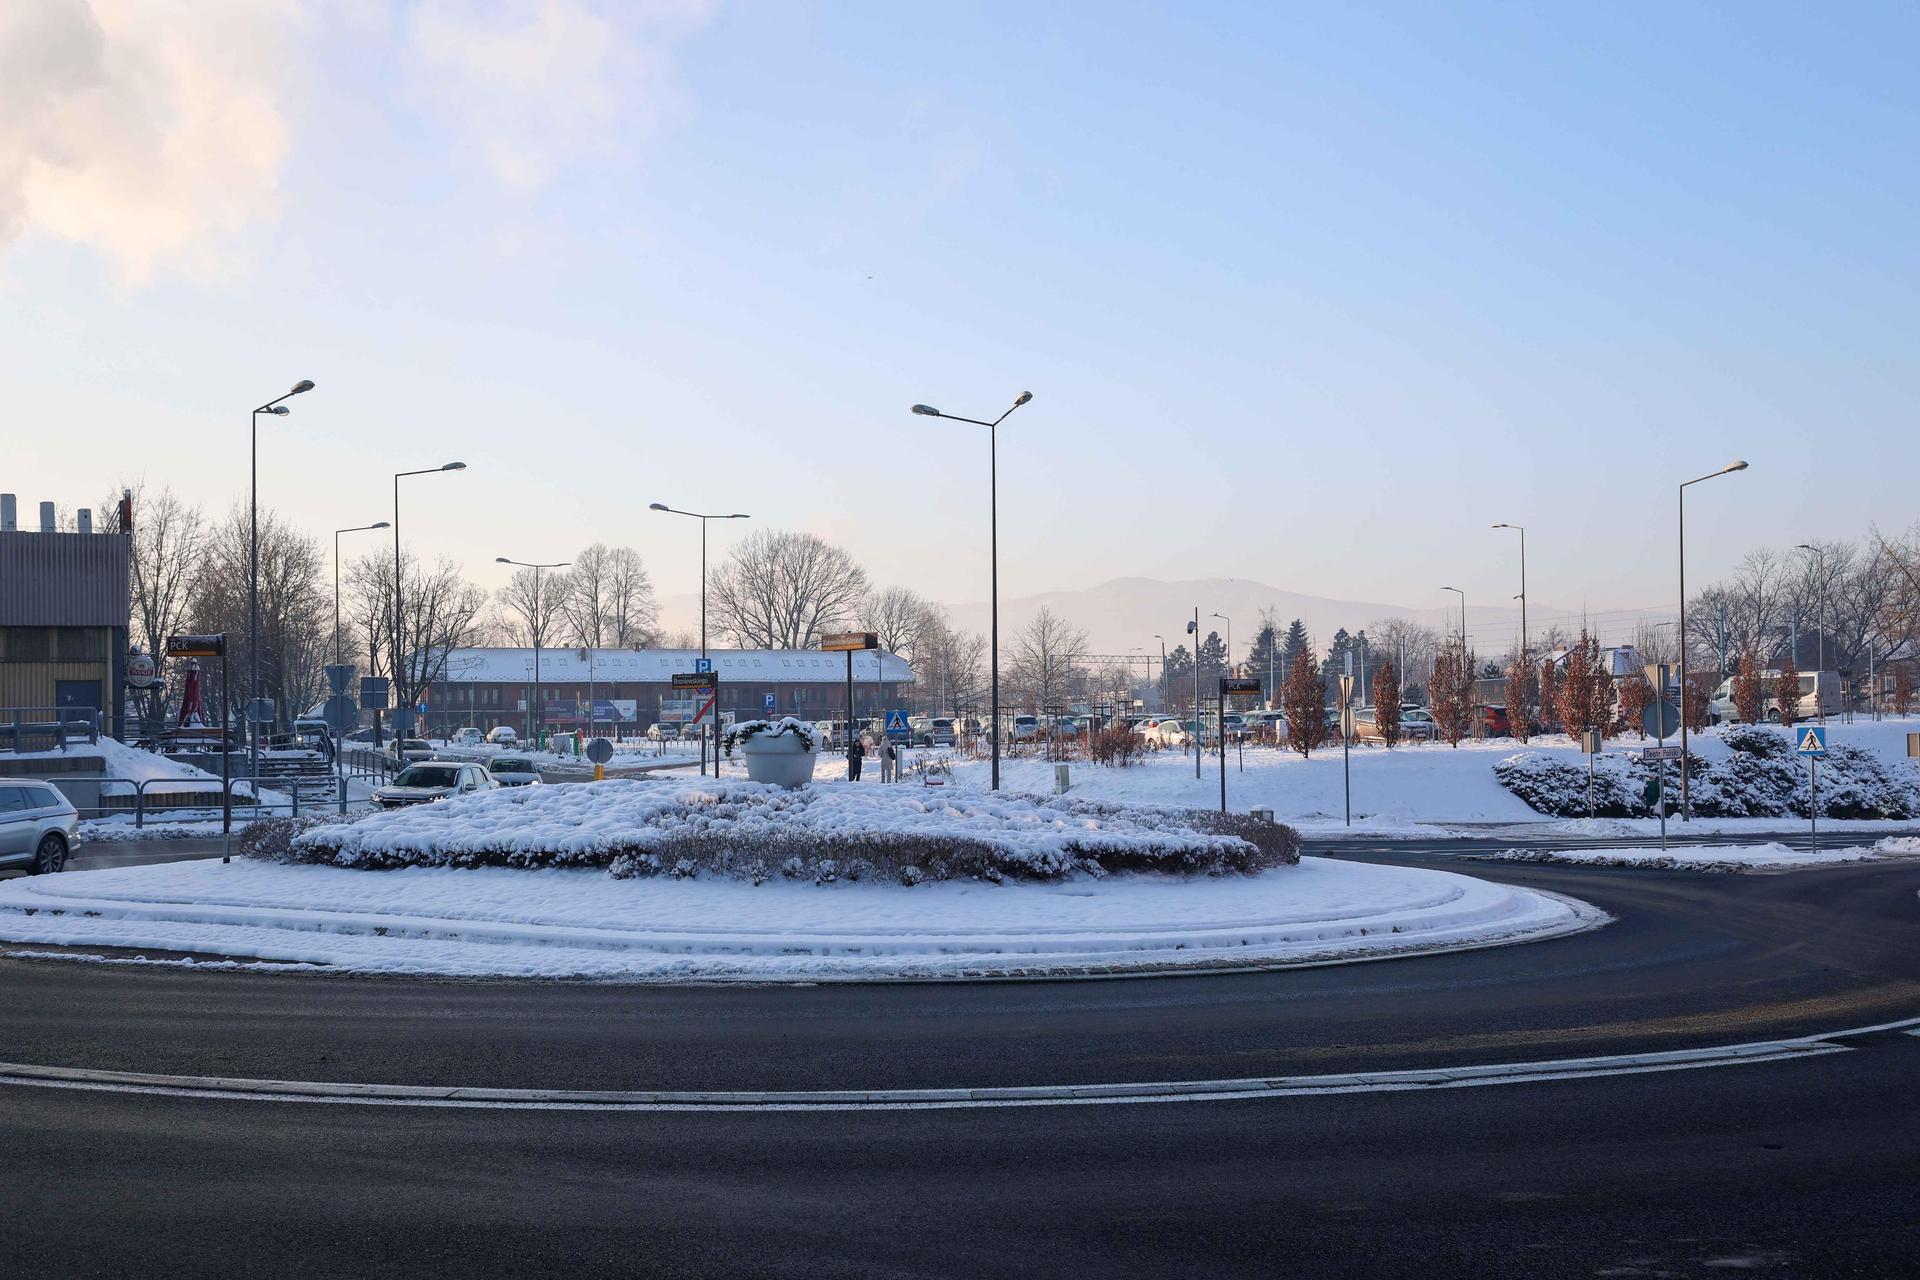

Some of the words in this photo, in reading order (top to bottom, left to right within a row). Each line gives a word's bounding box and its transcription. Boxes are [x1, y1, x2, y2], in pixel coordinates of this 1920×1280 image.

[170, 641, 188, 650] PCK
[699, 660, 709, 673] P
[674, 677, 709, 685] Broniewskiego
[1228, 682, 1241, 690] PCK
[765, 694, 774, 706] P
[1646, 750, 1661, 758] Teatr
[1662, 749, 1679, 757] Polski
